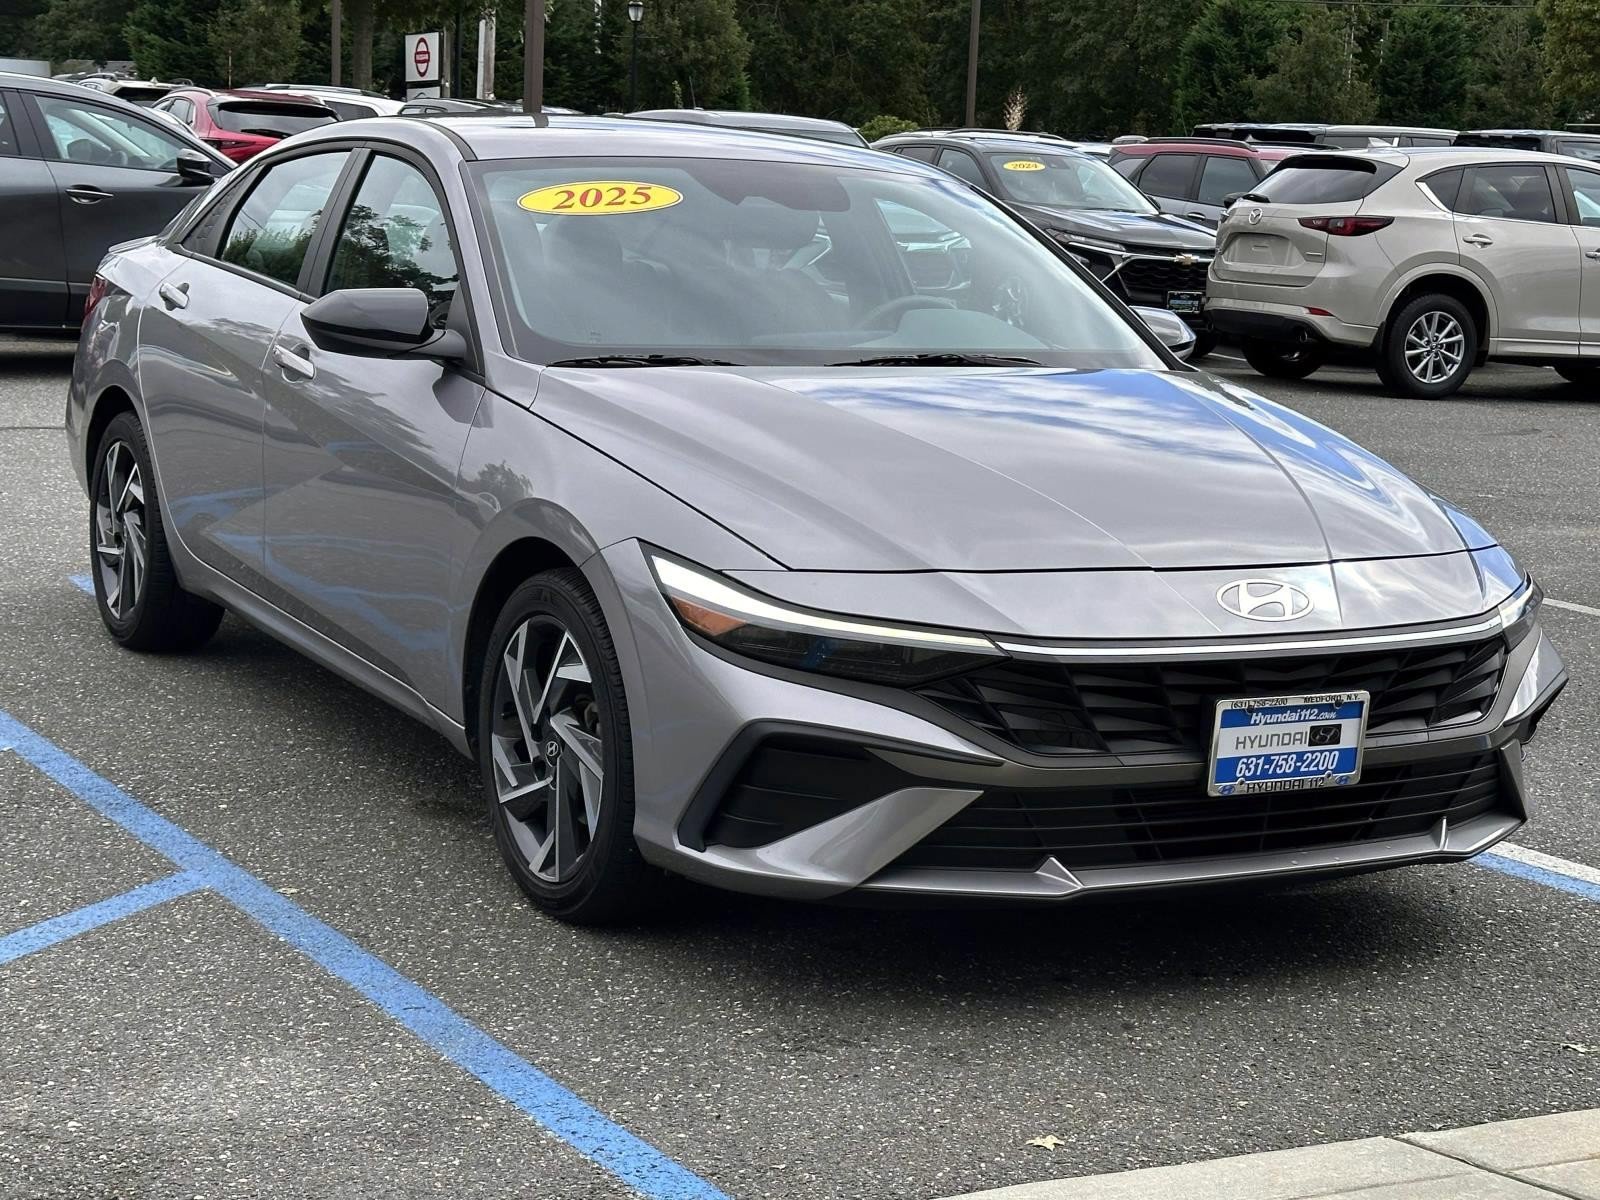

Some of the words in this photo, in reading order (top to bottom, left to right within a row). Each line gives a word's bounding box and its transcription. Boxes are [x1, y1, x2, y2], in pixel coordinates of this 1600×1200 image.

[552, 186, 652, 210] 2025
[1304, 694, 1344, 704] MEDFORD,
[1346, 693, 1361, 701] N.Y.
[1250, 708, 1337, 726] Hyundai112.com
[1235, 731, 1308, 750] HYUNDAI
[1236, 750, 1340, 777] 631-758-2200
[1246, 779, 1304, 793] HYUNDAI
[1308, 777, 1325, 789] 112
